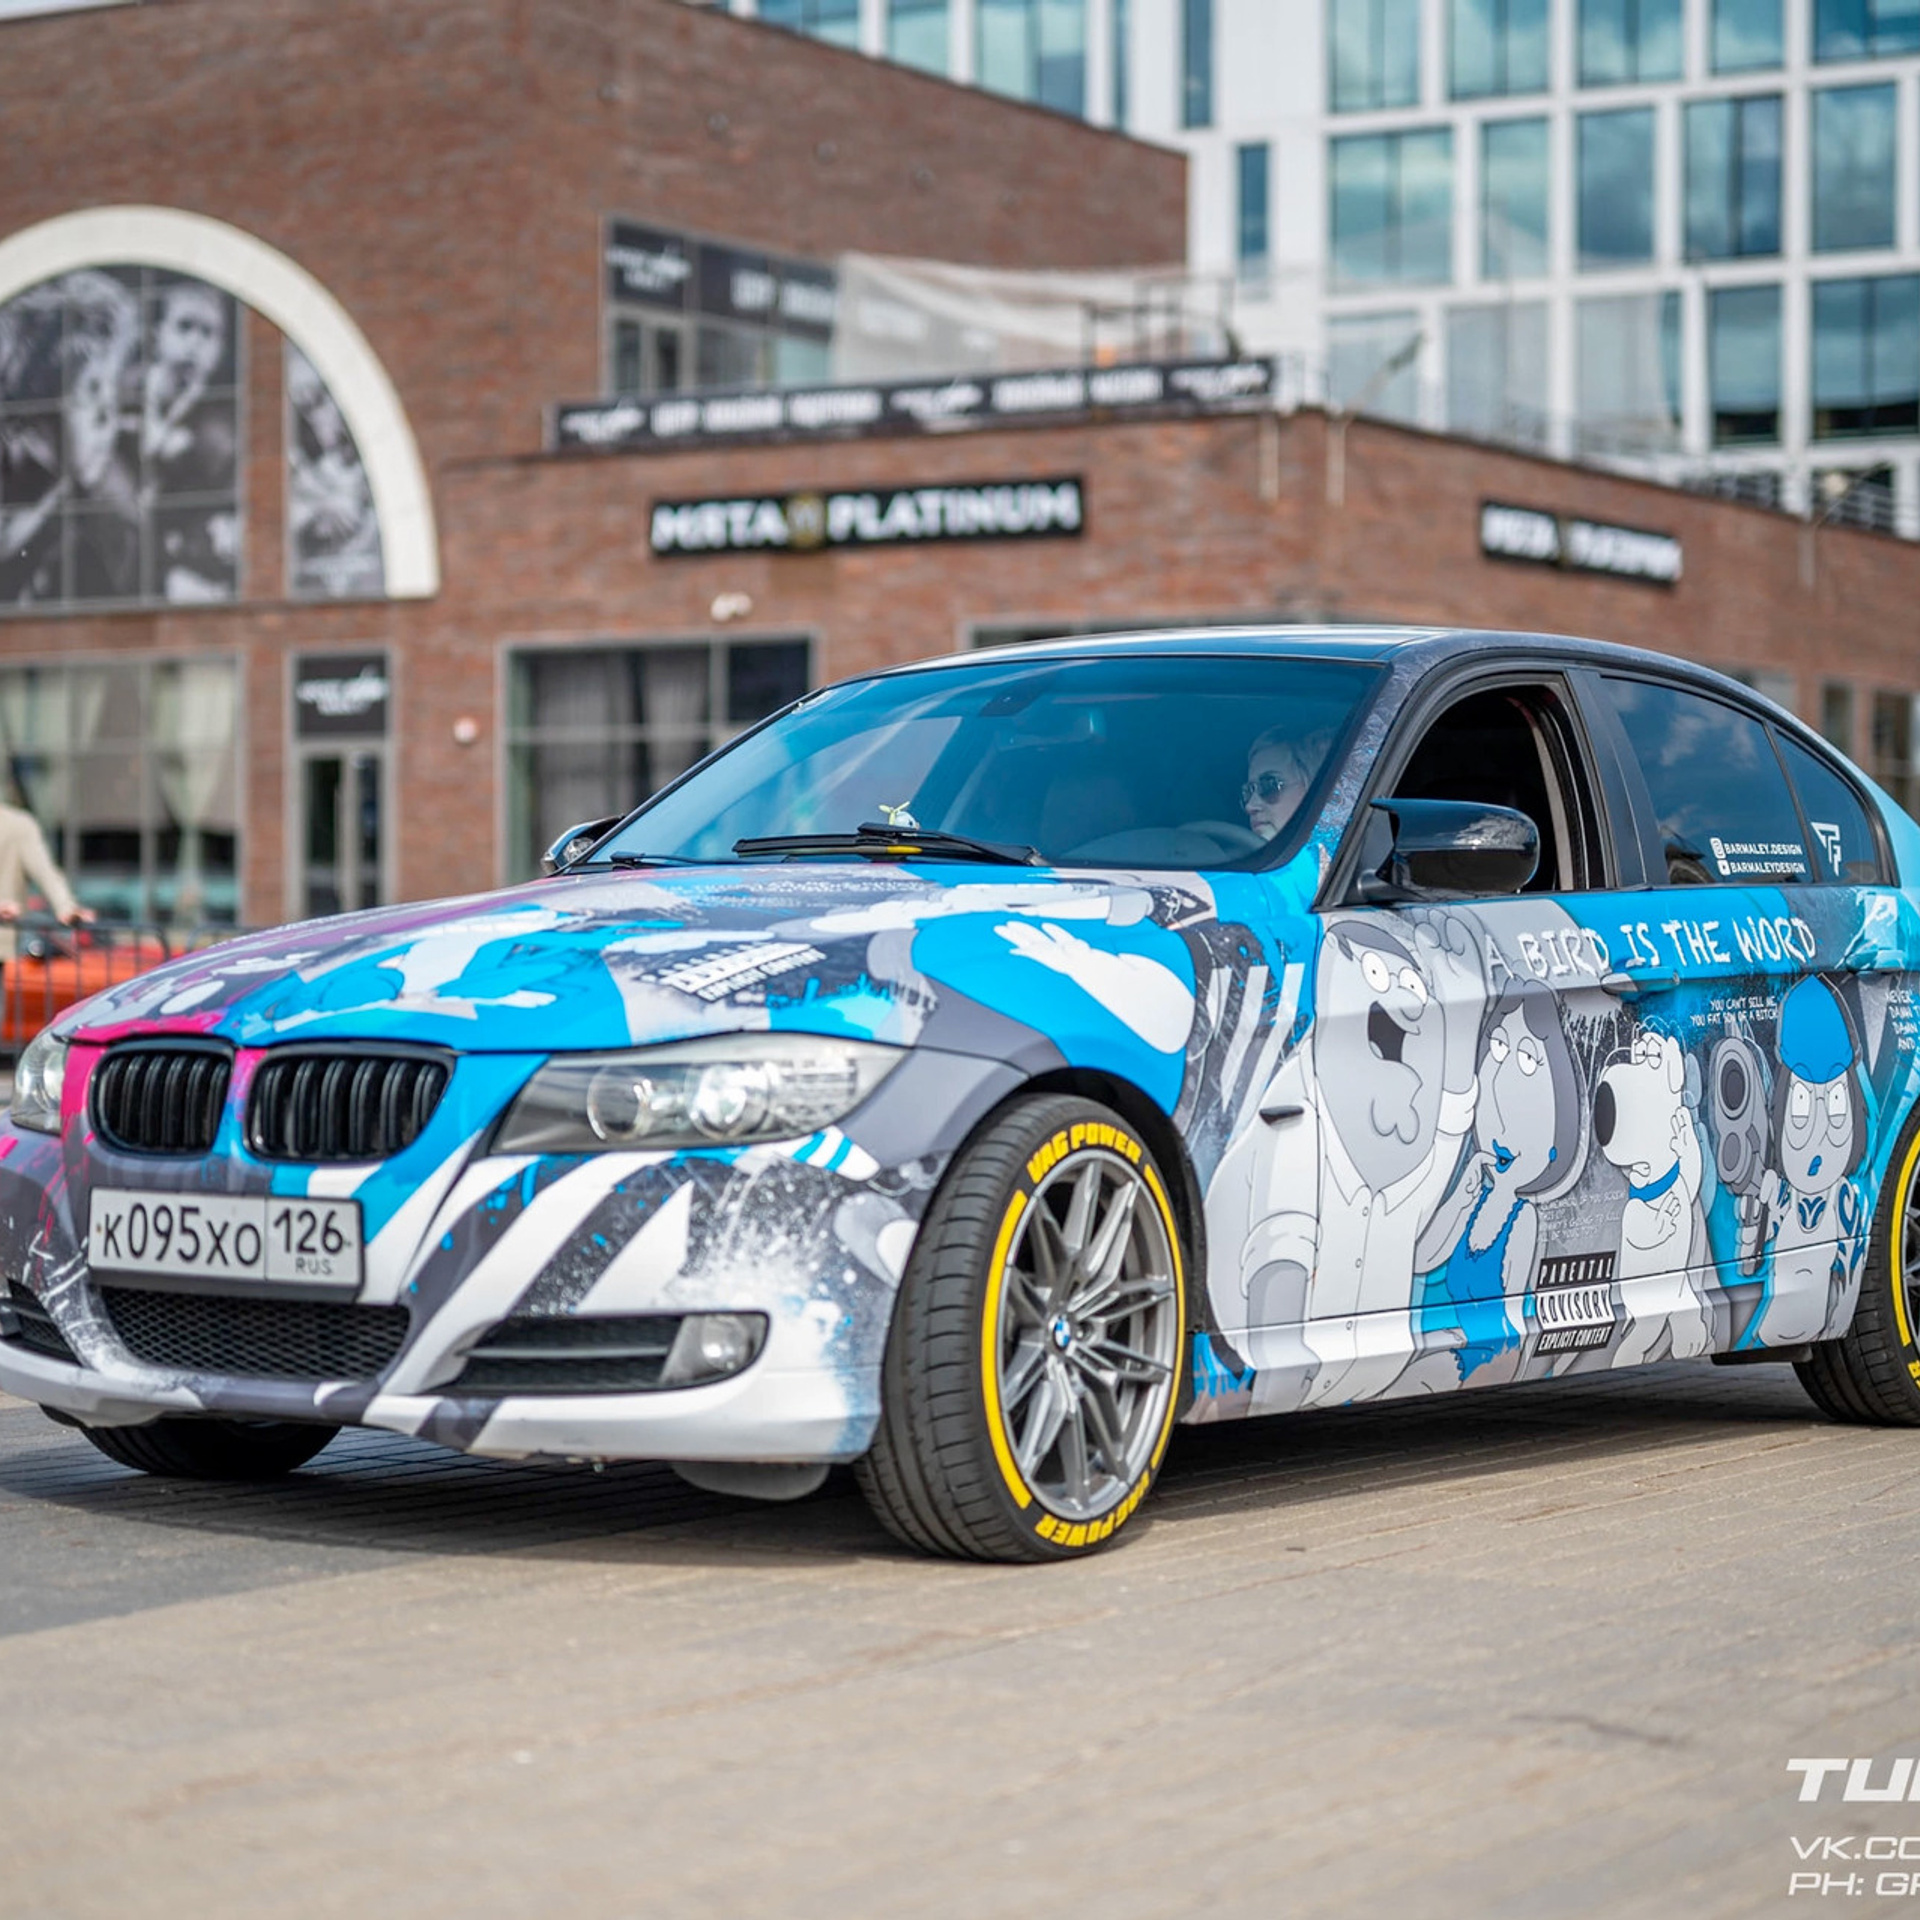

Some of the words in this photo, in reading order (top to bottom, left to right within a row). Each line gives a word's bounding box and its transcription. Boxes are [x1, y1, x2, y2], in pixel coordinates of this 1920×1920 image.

[828, 482, 1081, 542] PLATINUM
[1724, 843, 1803, 856] BARMALEY.DESIGN
[1730, 862, 1806, 874] BARMALEYDESIGN
[1486, 934, 1516, 982] A
[1520, 927, 1609, 977] BIRD
[1620, 922, 1660, 968] IS
[1663, 919, 1730, 967] THE
[1734, 916, 1815, 963] WORD
[1710, 999, 1725, 1011] YOU
[1748, 996, 1764, 1008] SELL
[1690, 1014, 1706, 1026] YOU
[1026, 1130, 1069, 1184] VAG
[1070, 1122, 1142, 1164] POWER
[273, 1208, 344, 1255] 126
[295, 1258, 333, 1275] RUS
[1540, 1258, 1613, 1285] PARENTAL
[1541, 1289, 1610, 1323] ADVISORY
[1538, 1330, 1578, 1351] EXPLICIT
[1574, 1326, 1612, 1346] CONTENT
[1034, 1513, 1116, 1547] POWER
